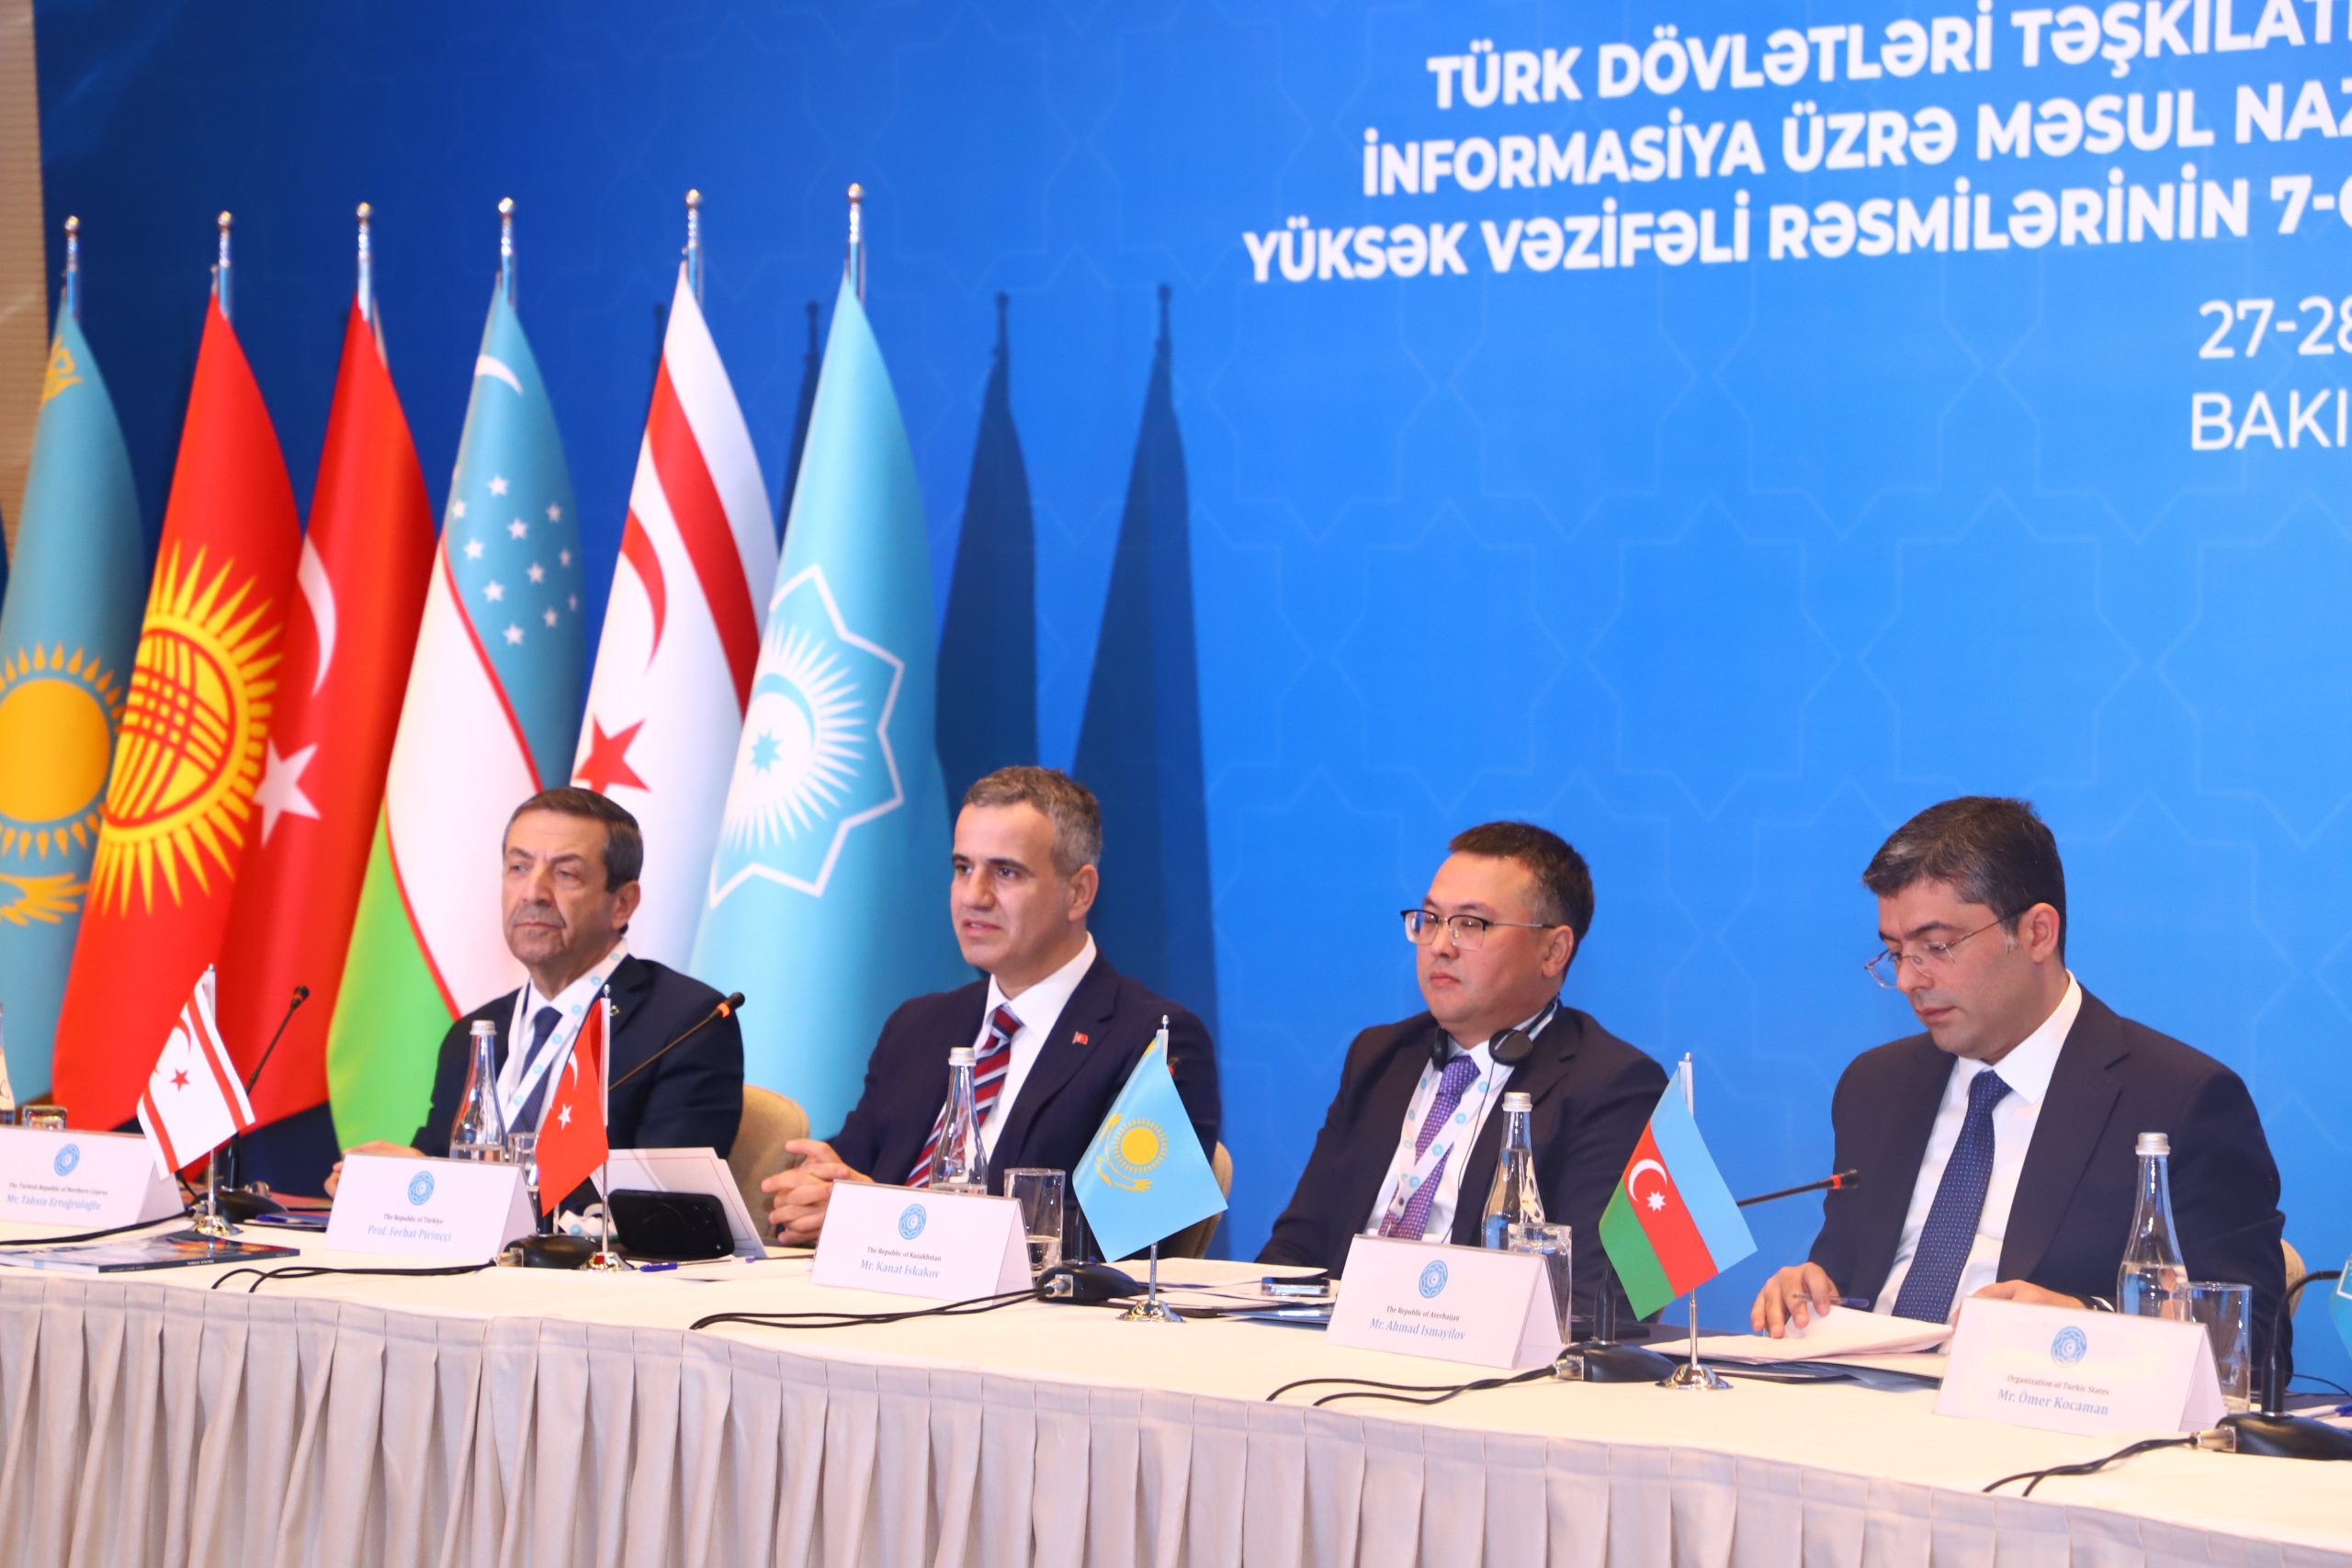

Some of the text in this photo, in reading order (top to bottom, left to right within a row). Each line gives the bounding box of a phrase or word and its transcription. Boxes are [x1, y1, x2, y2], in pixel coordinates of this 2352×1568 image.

[1427, 39, 1582, 109] TÜRK
[1598, 0, 1993, 98] DÖVLƏTLƏRİ
[1363, 107, 1766, 196] İNFORMASİYA
[1782, 101, 1958, 173] ÜZRƏ
[1976, 89, 2215, 161] MƏSUL
[1243, 162, 2352, 282] YÜKSƏK VƏZİFƏLİ RƏSMİLƏRİNİN 7-
[2191, 389, 2348, 451] BAKI
[368, 1224, 388, 1235] Prof.
[390, 1227, 417, 1239] Ferhat
[877, 1248, 901, 1257] Republic
[910, 1252, 942, 1261] Kazakhstan
[860, 1259, 941, 1279] Mr. Kanat Iskakov
[1386, 1305, 1396, 1314] The
[1397, 1307, 1421, 1317] Republic
[1430, 1311, 1460, 1322] Azerbaijan
[1370, 1318, 1466, 1341] Mr. Ahmad Ismayilov
[2007, 1374, 2052, 1387] Organization
[2064, 1382, 2086, 1392] Turkic
[2087, 1385, 2109, 1395] States
[1998, 1389, 2109, 1415] Mr. Ömer Kocaman
